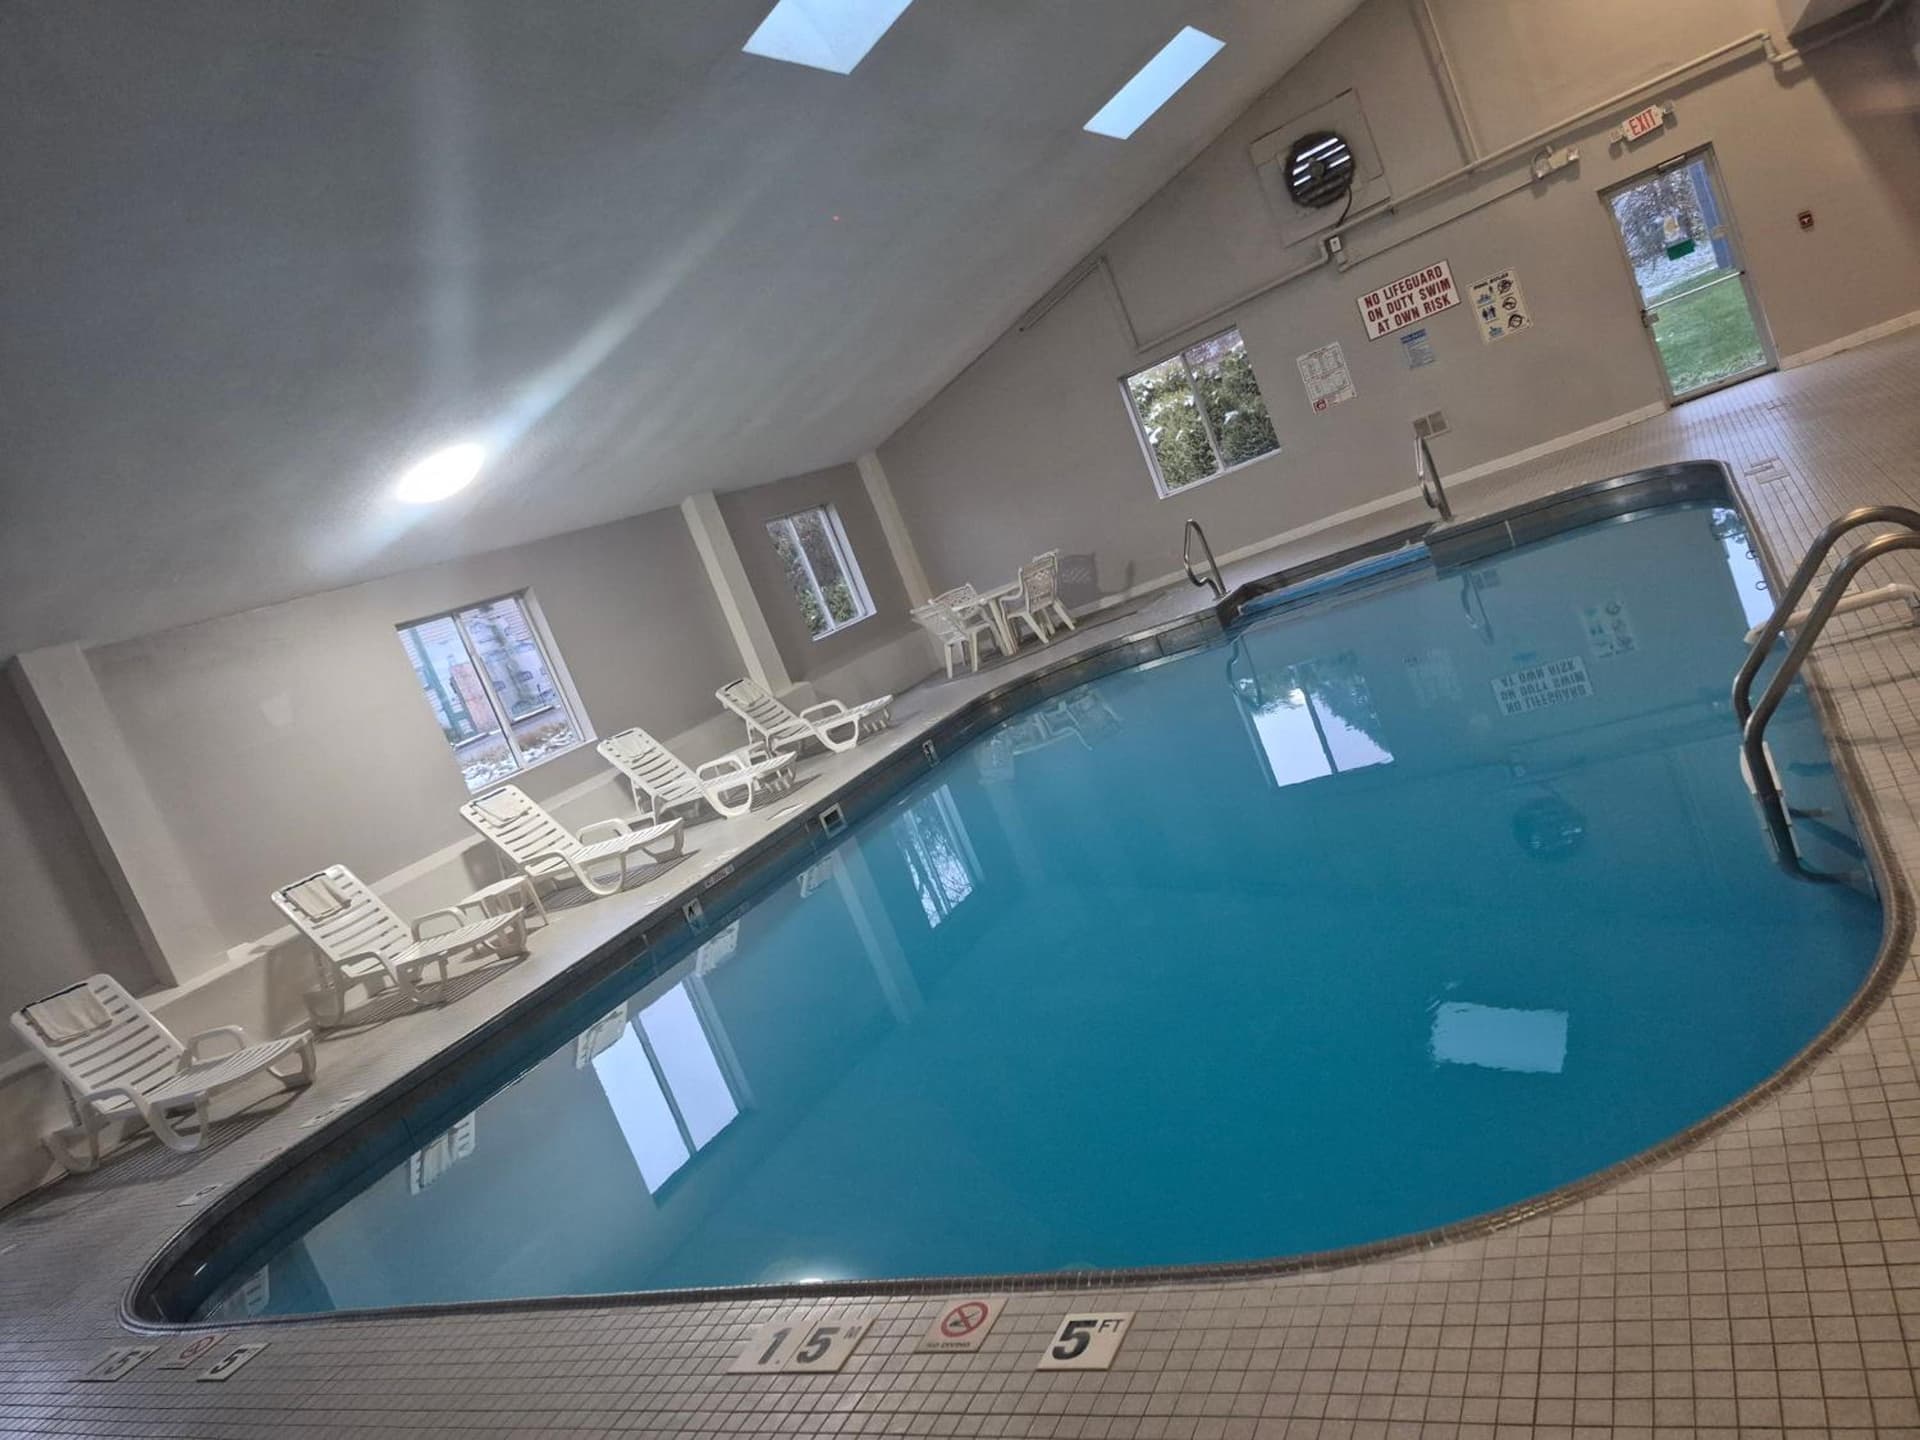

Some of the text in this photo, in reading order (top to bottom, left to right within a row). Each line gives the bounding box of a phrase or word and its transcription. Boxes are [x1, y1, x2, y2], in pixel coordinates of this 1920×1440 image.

[1629, 109, 1656, 135] EXIT
[1364, 265, 1443, 309] NO LIFEGUARD
[1367, 307, 1384, 322] ON
[1386, 293, 1415, 314] DUTY
[1419, 278, 1451, 301] SWIM
[1377, 294, 1451, 334] AT OWN RISK
[1052, 1318, 1125, 1360] 5 FT
